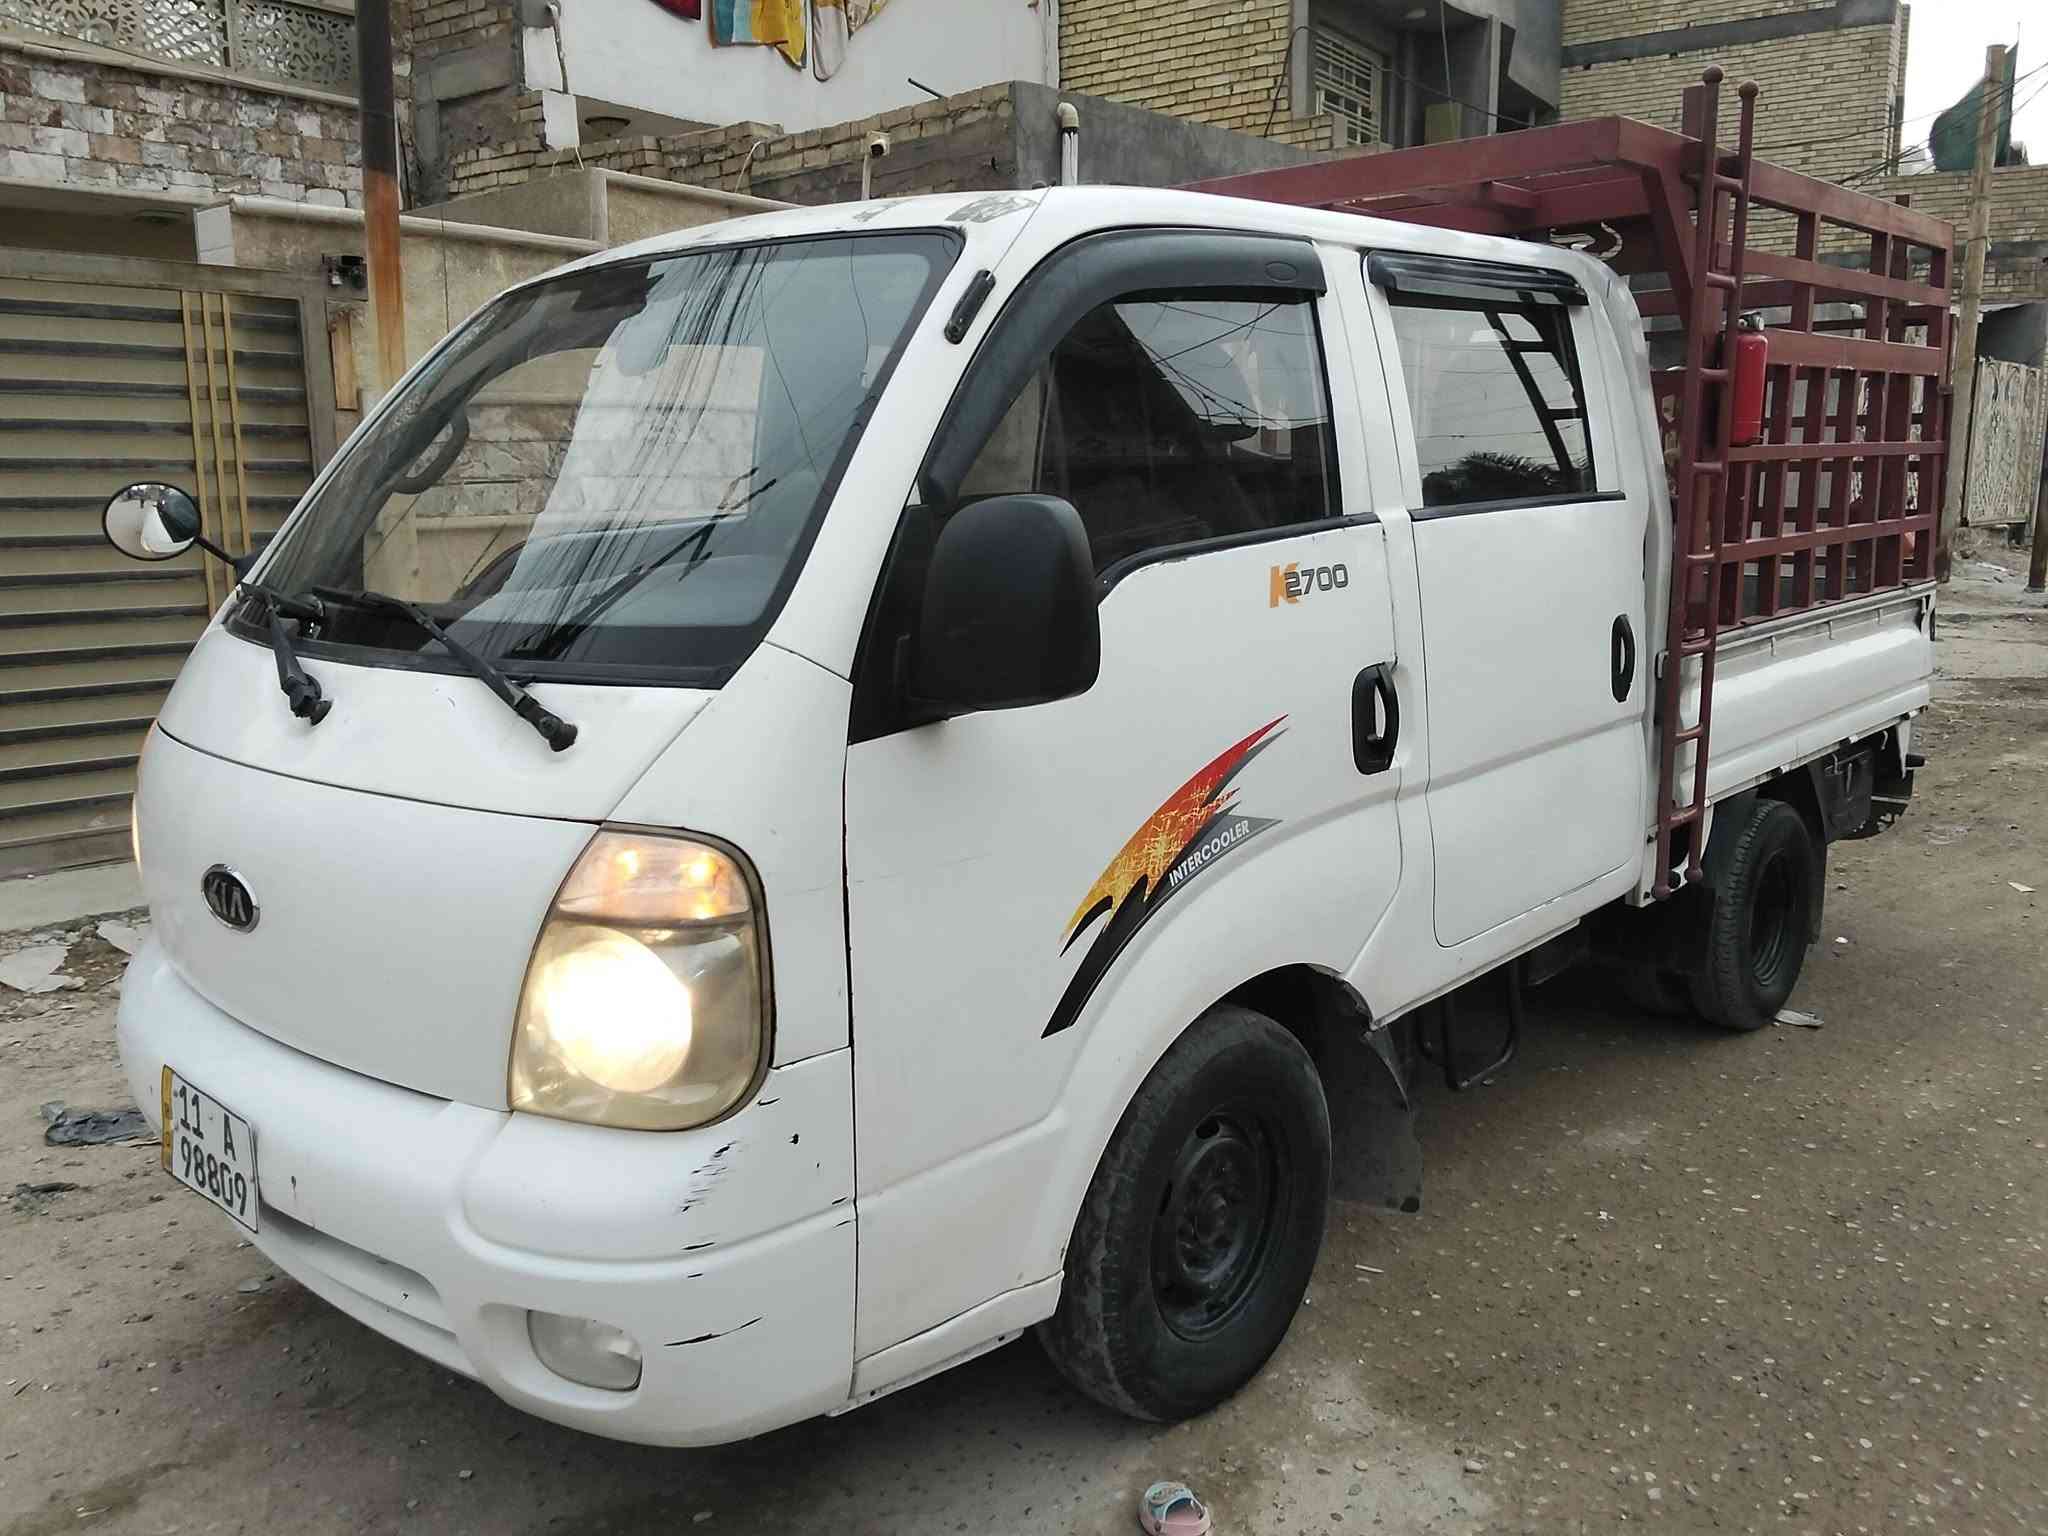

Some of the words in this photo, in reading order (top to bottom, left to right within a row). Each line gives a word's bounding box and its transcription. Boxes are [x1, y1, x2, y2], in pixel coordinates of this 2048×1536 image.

[1269, 563, 1348, 608] K2700
[1168, 820, 1250, 887] INTERCOOLER
[207, 876, 247, 922] KIA
[179, 1085, 204, 1140] 11
[223, 1112, 237, 1162] A
[181, 1135, 248, 1216] 98809
